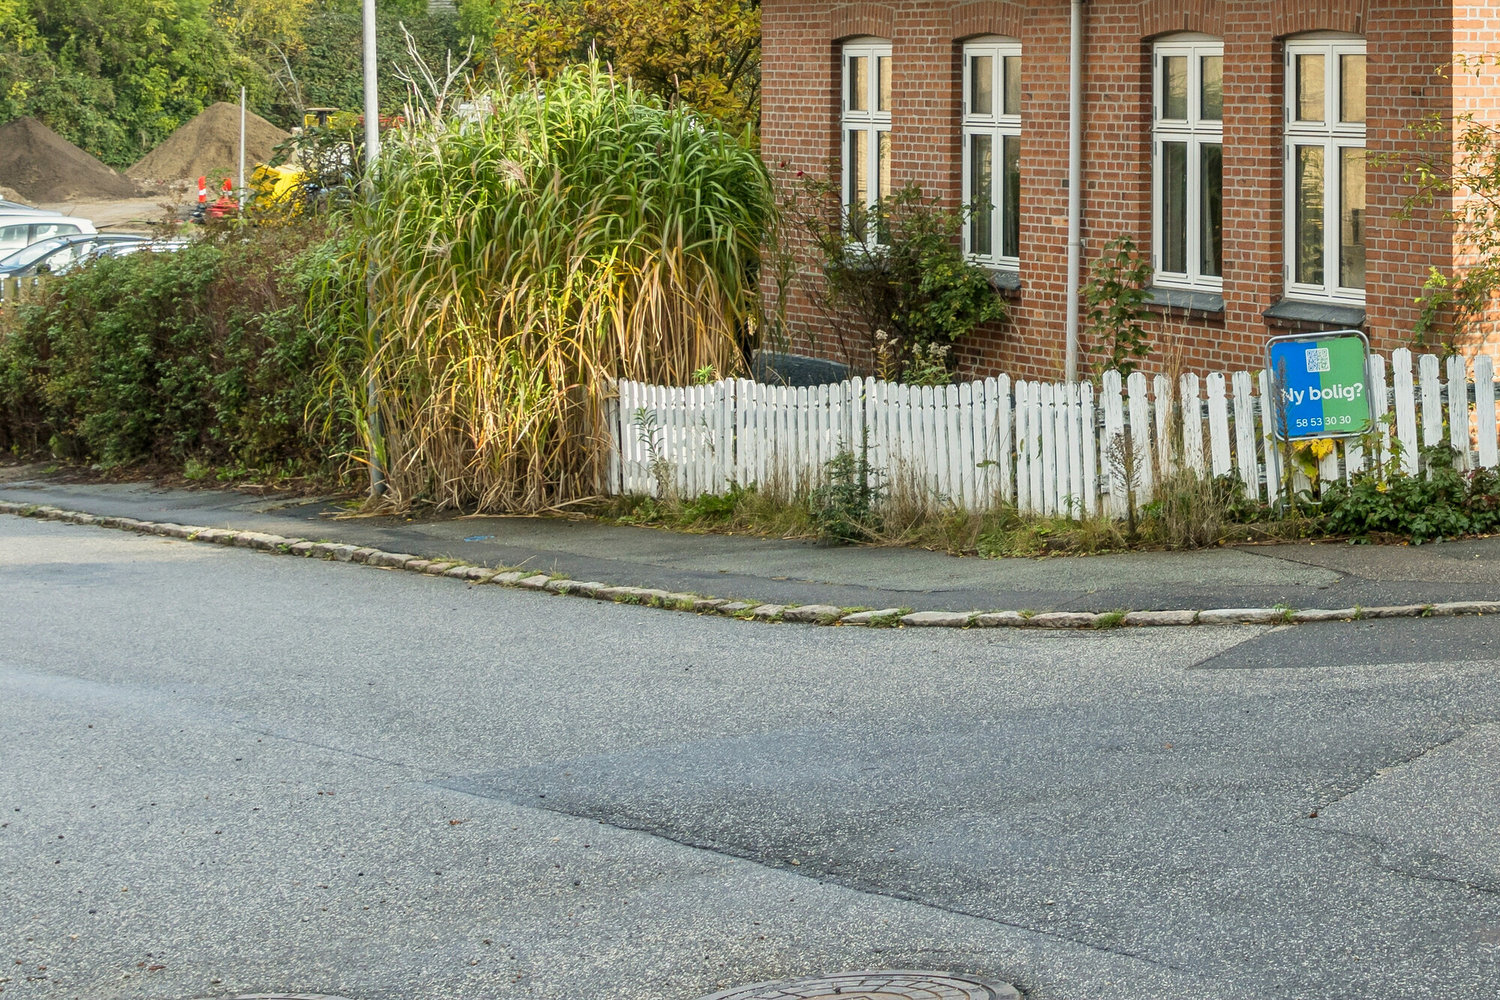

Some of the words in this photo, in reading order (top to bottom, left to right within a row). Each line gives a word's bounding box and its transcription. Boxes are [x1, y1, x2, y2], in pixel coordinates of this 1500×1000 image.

[1282, 387, 1304, 405] Ny
[1309, 383, 1363, 402] bolig?
[1296, 418, 1308, 428] 58
[1310, 417, 1323, 427] 53
[1325, 416, 1337, 425] 30
[1339, 415, 1351, 424] 30
